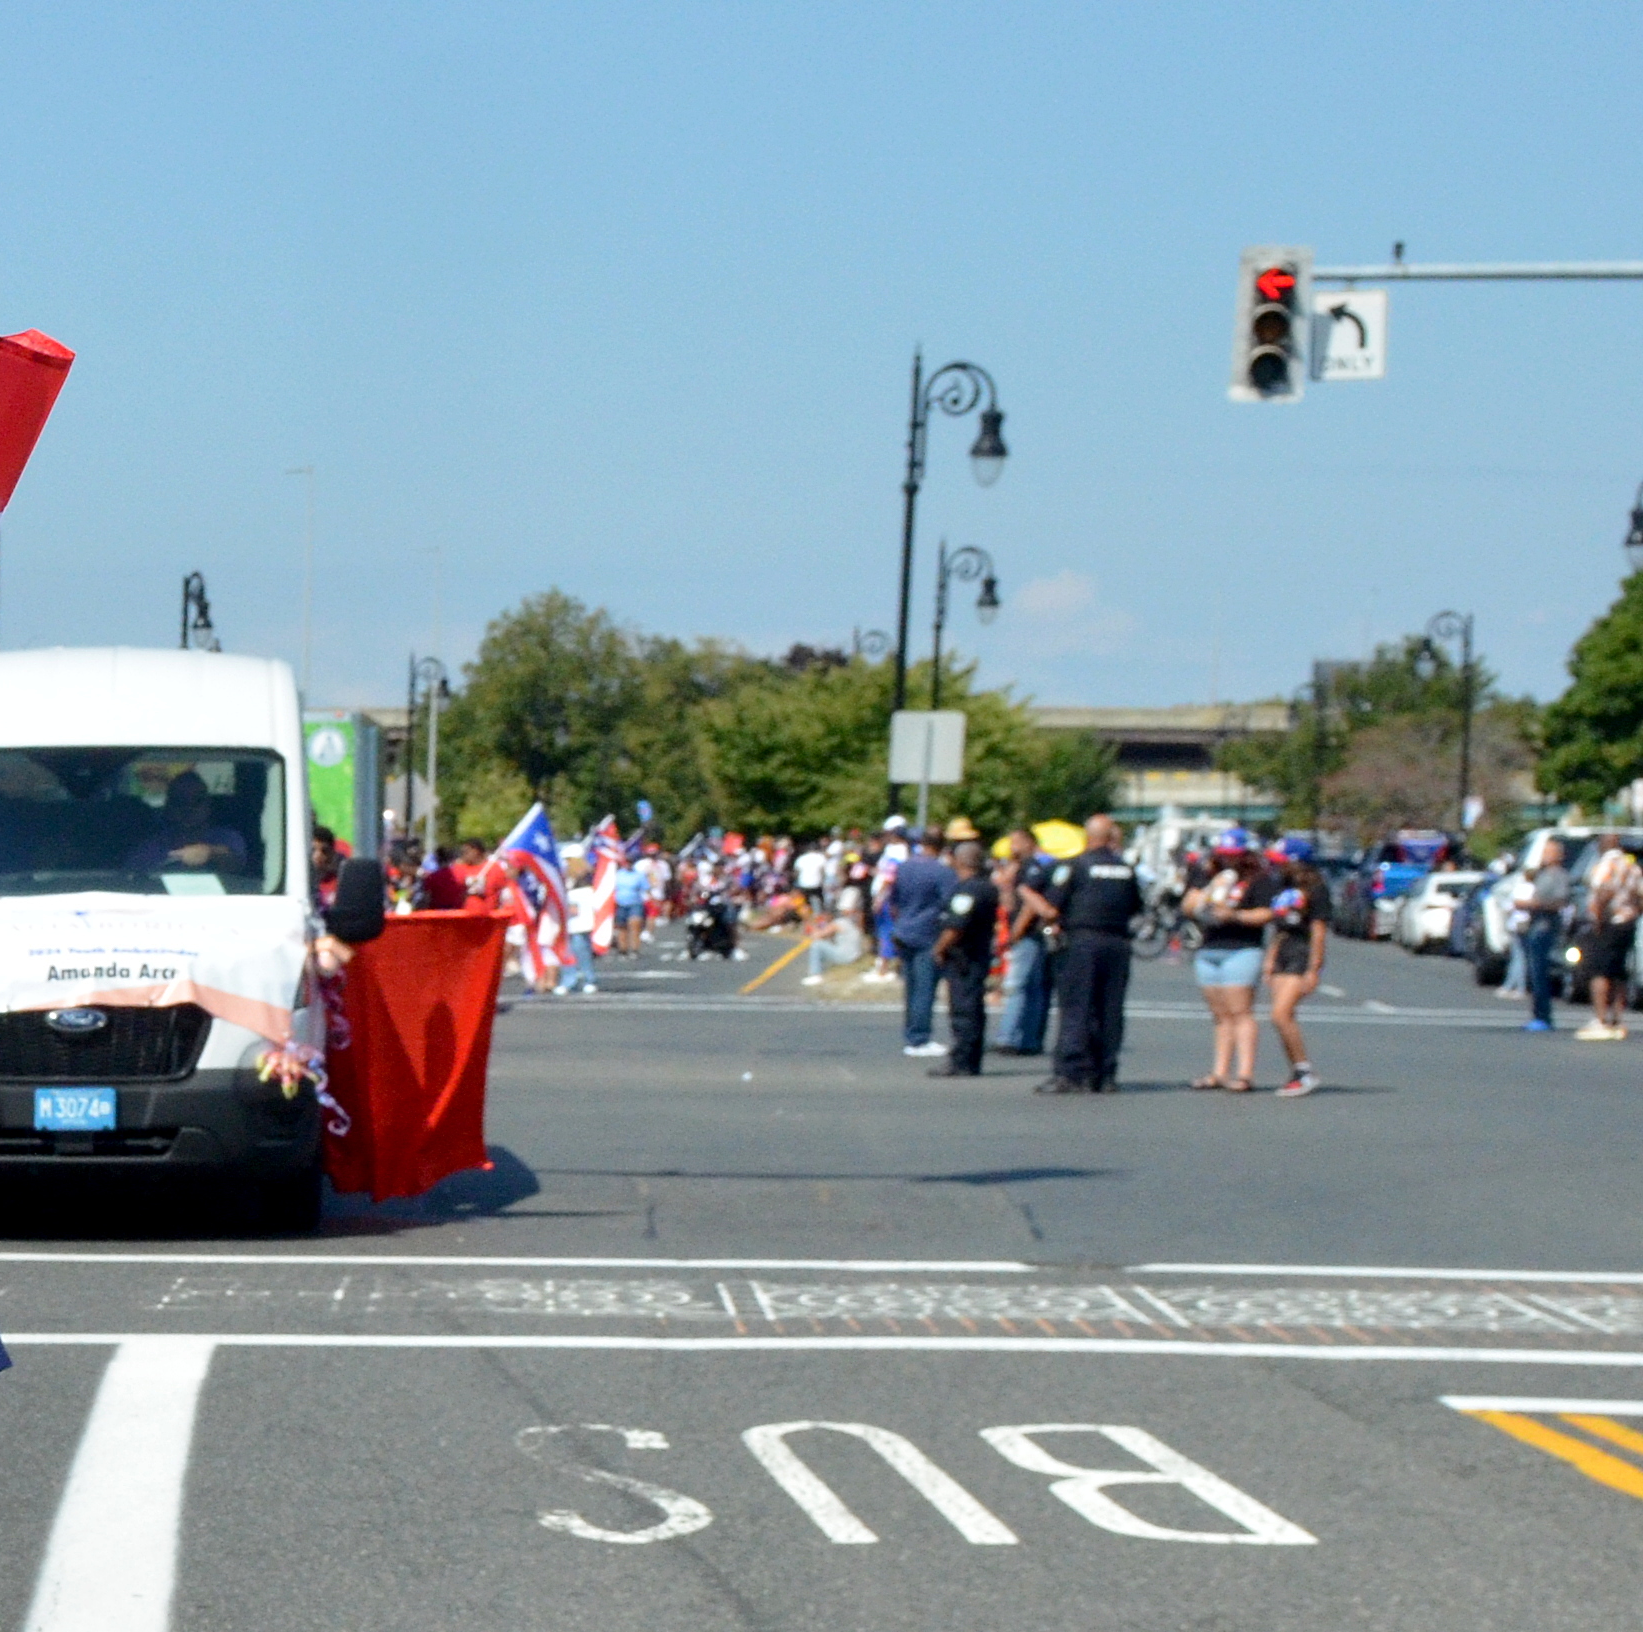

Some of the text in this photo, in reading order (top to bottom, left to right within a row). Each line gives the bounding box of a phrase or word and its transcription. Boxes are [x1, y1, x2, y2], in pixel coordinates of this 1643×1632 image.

[47, 960, 130, 982] Amanda
[55, 1096, 100, 1119] 3074
[516, 1421, 1320, 1546] BUS
